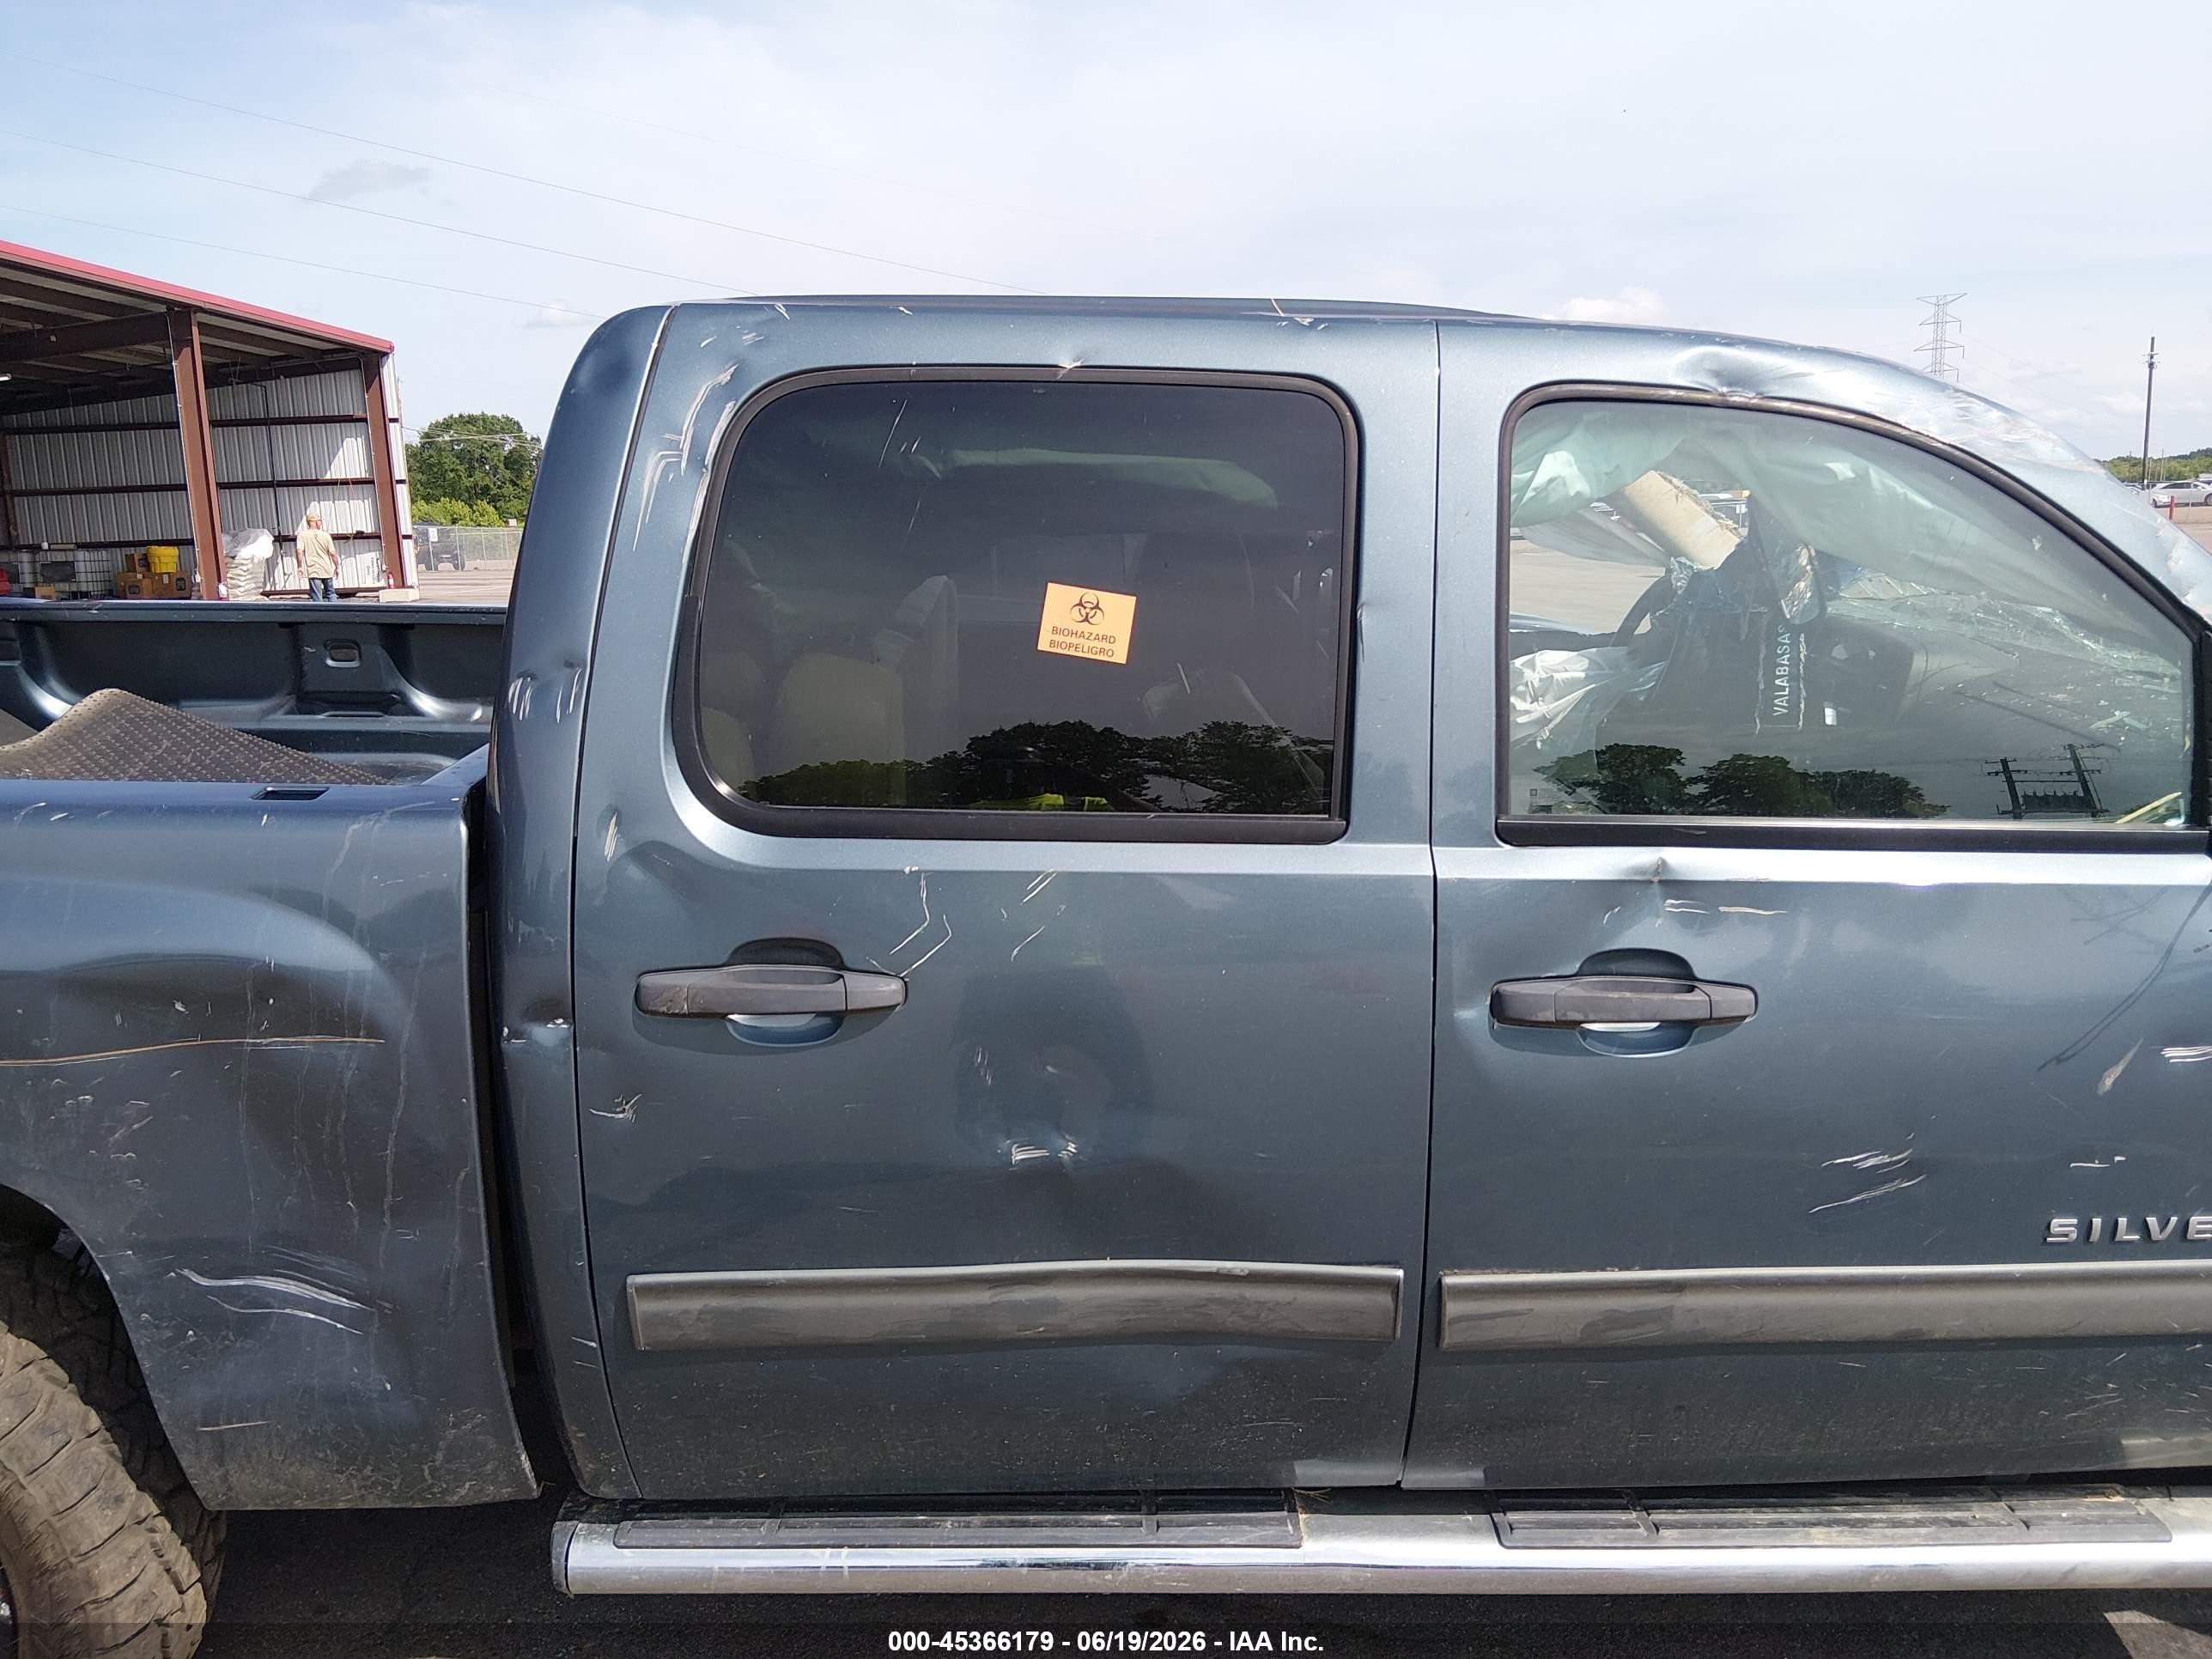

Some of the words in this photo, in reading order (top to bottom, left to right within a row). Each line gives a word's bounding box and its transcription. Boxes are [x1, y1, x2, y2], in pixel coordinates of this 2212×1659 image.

[1051, 626, 1116, 645] BIOHAZARD
[1049, 639, 1115, 658] BIOPELIGRO
[2046, 1215, 2212, 1243] SILVE
